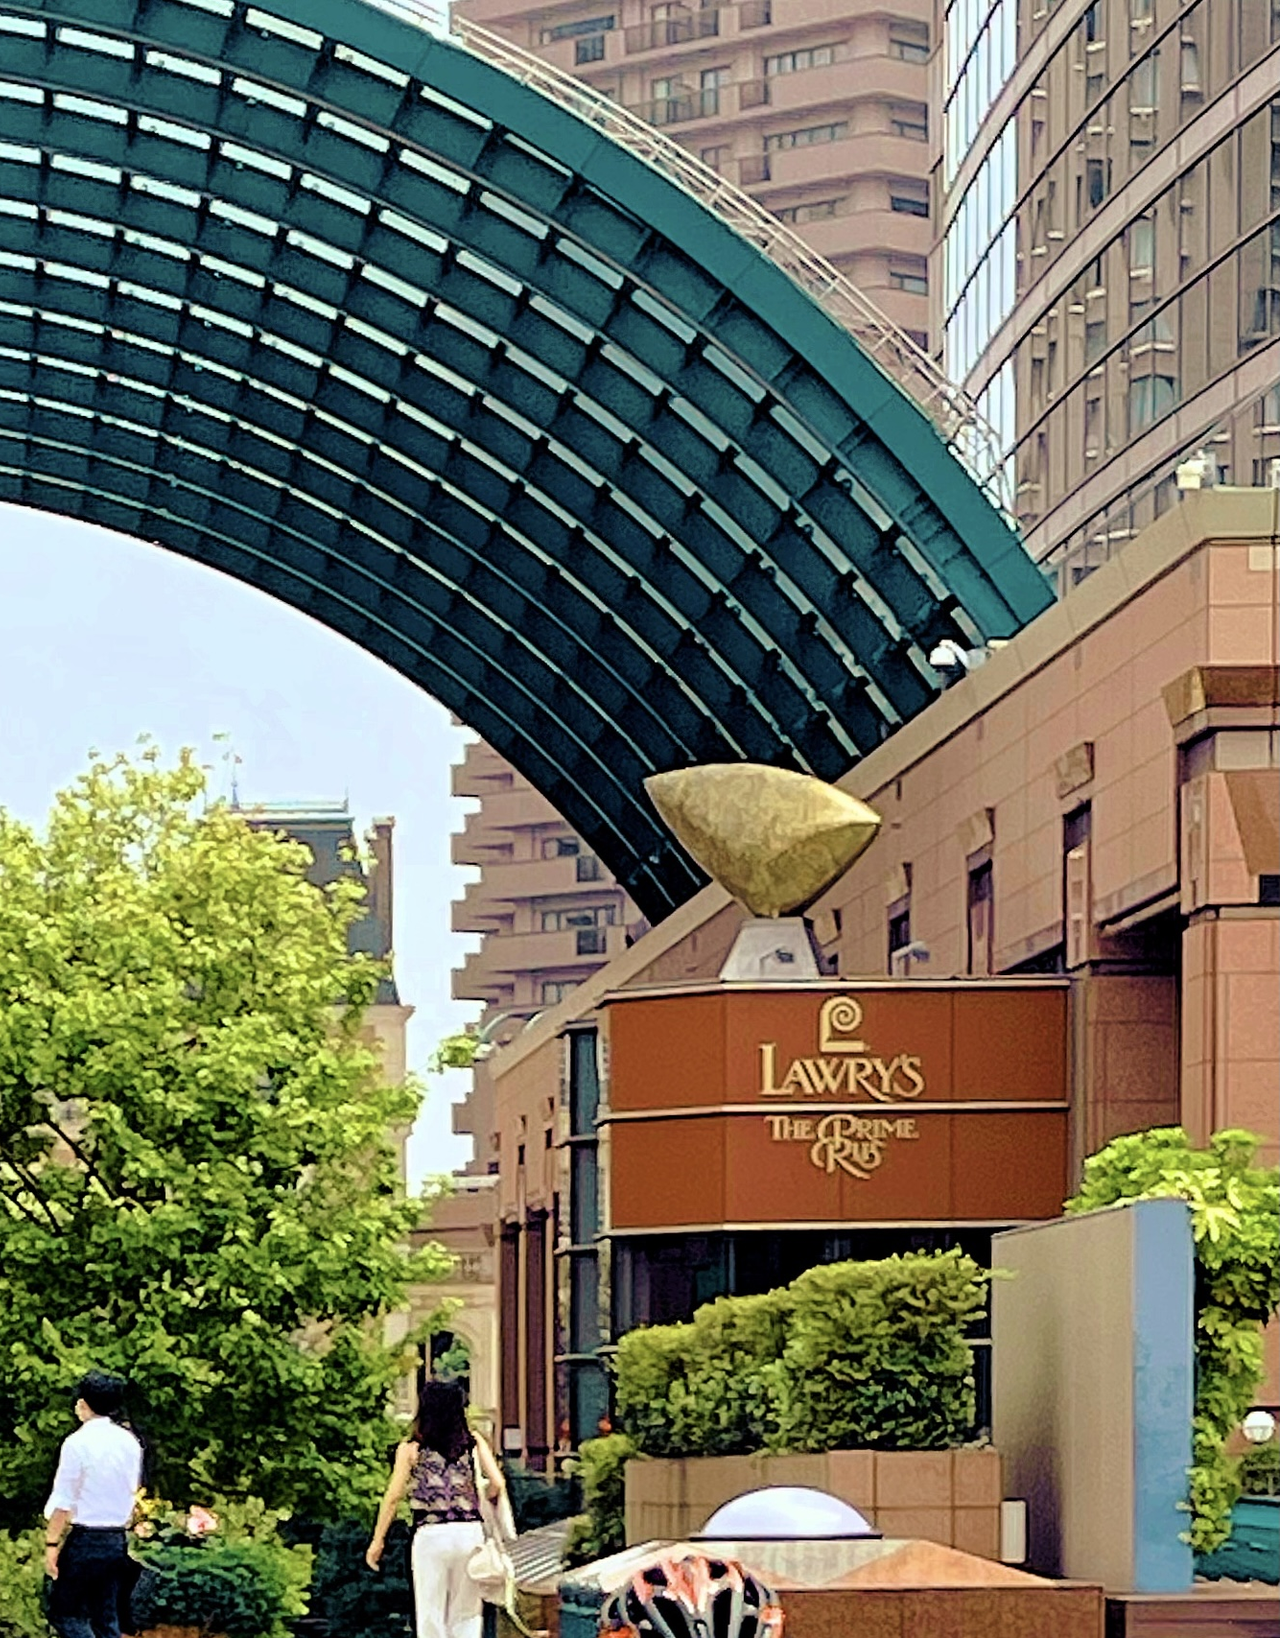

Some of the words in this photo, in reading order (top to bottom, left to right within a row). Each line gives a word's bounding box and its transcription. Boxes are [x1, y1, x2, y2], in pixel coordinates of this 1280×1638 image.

[759, 1043, 924, 1102] LAWRY'S
[764, 1116, 816, 1140] THE
[817, 1114, 919, 1147] PRIME
